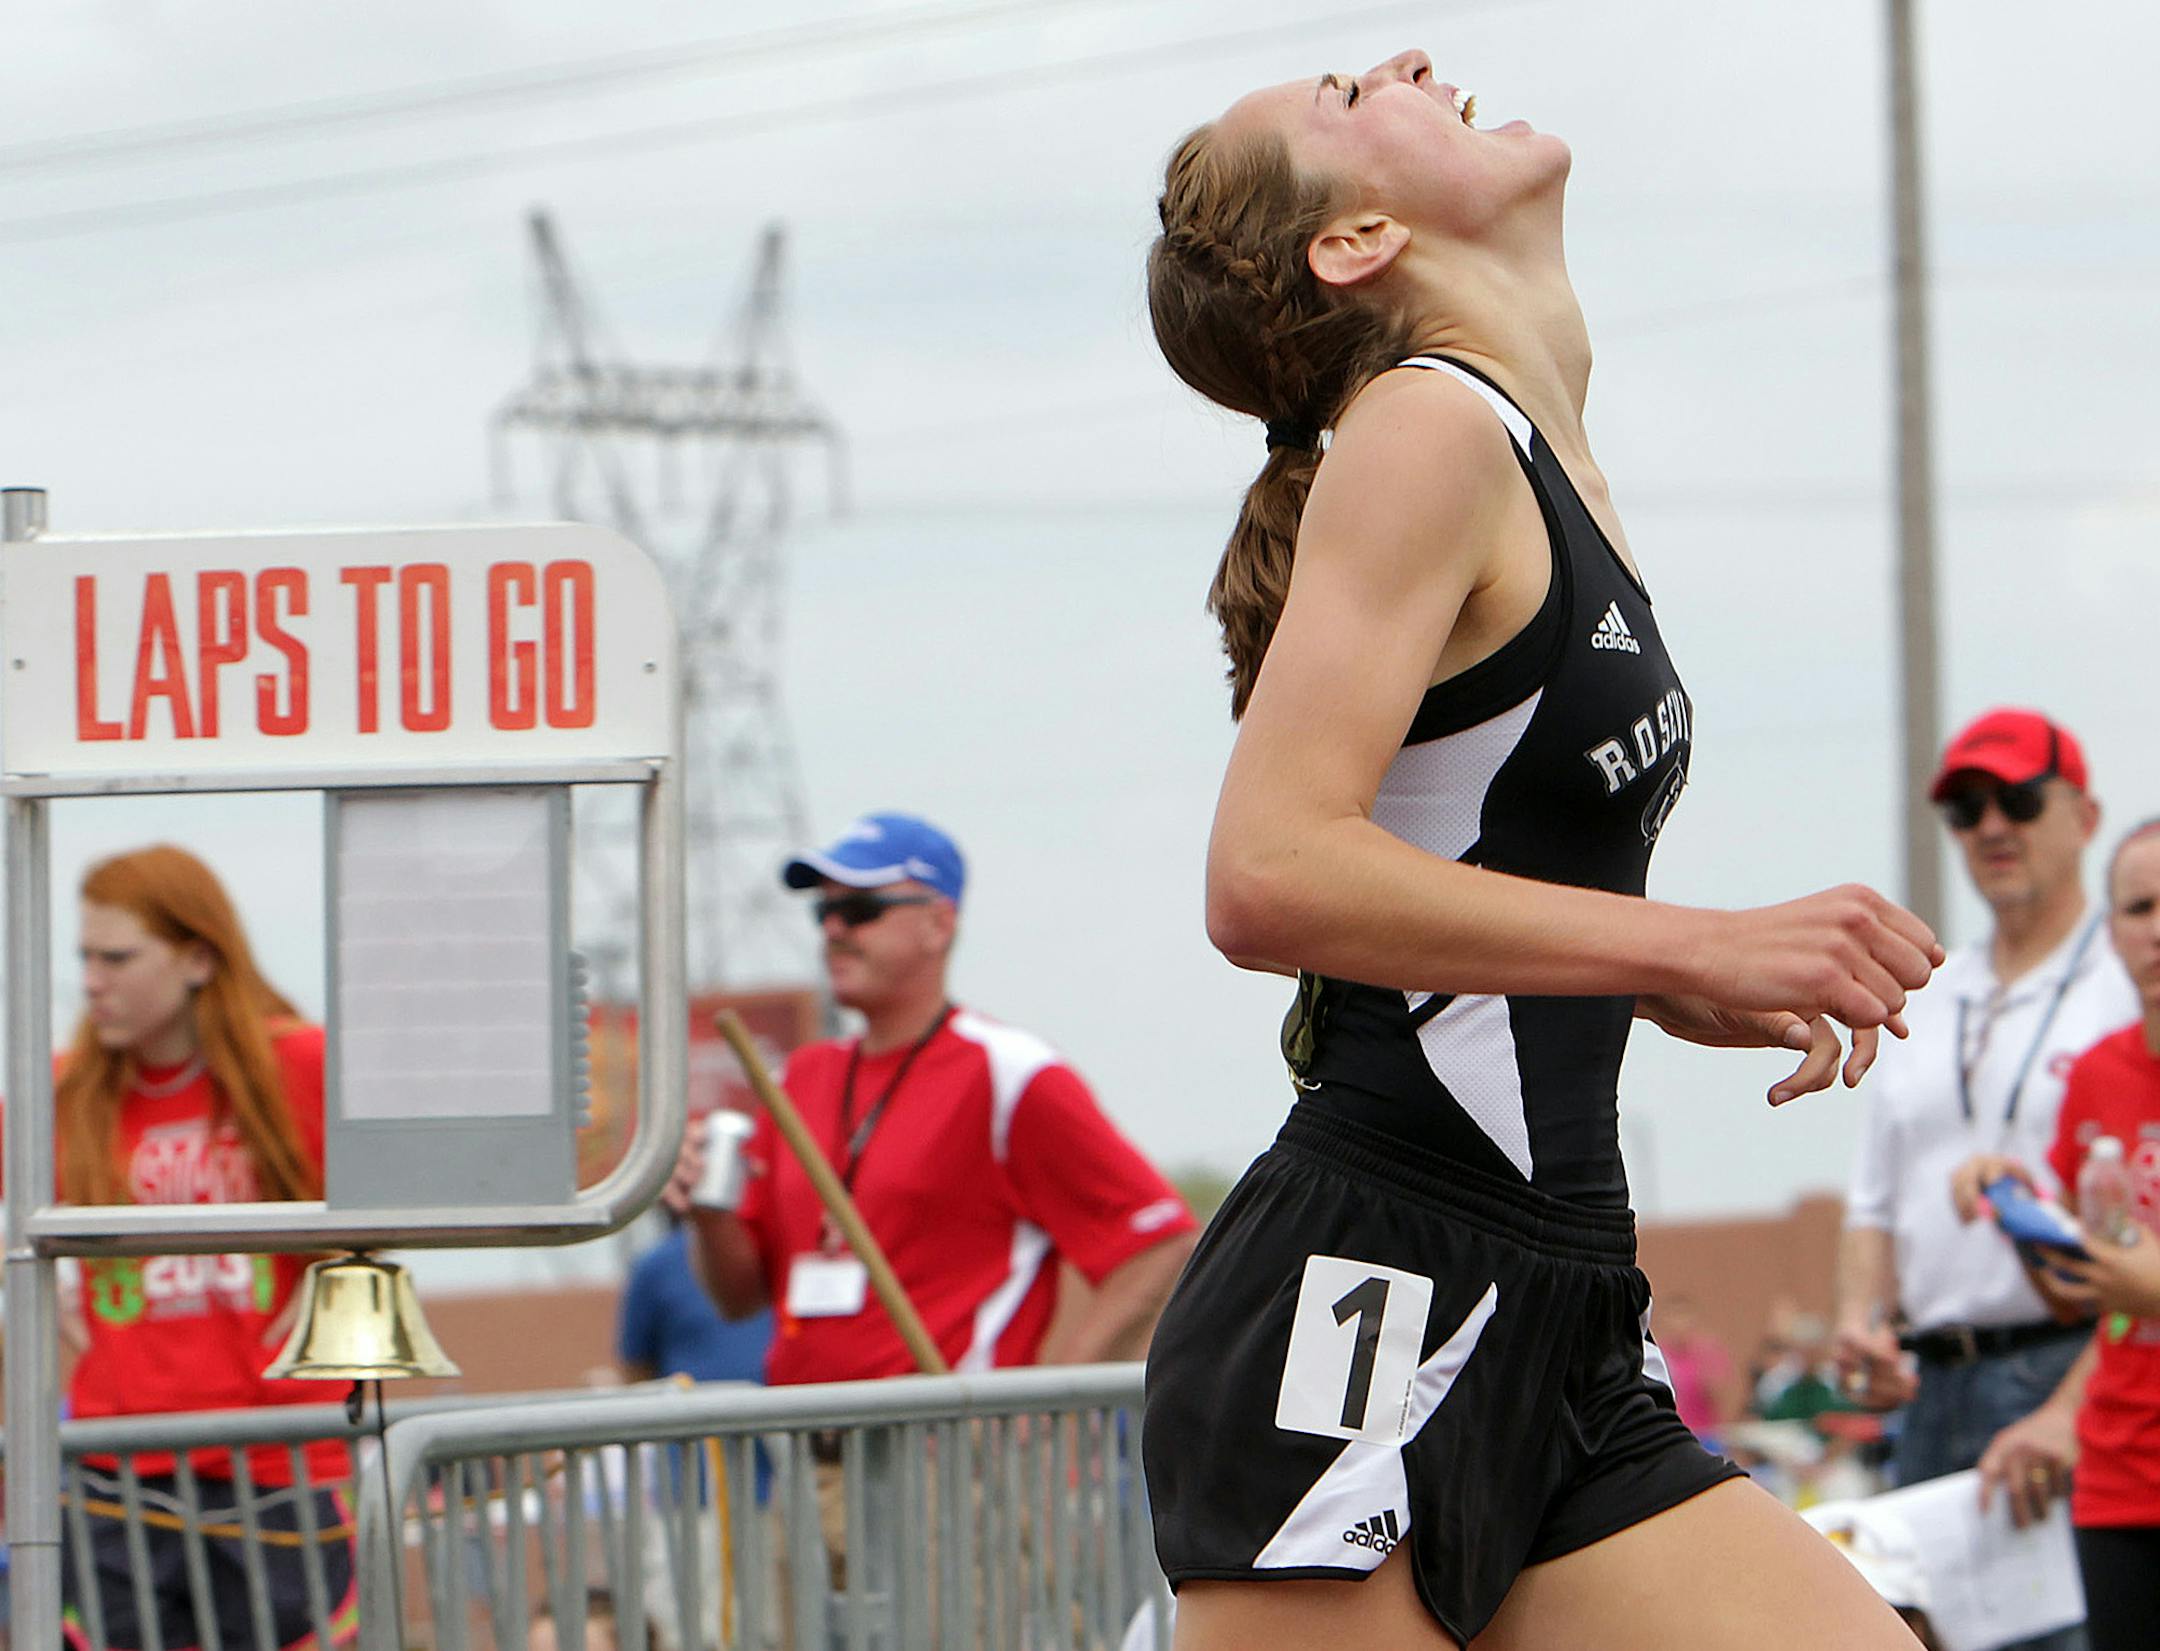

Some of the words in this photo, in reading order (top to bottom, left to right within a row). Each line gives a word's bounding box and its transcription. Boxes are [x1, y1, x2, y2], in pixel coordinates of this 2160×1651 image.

[76, 567, 310, 741] LAPS
[340, 563, 453, 734] TO
[488, 560, 596, 731] GO
[1591, 630, 1641, 655] adidas
[1331, 1277, 1391, 1431] 1
[1342, 1529, 1397, 1556] adida
